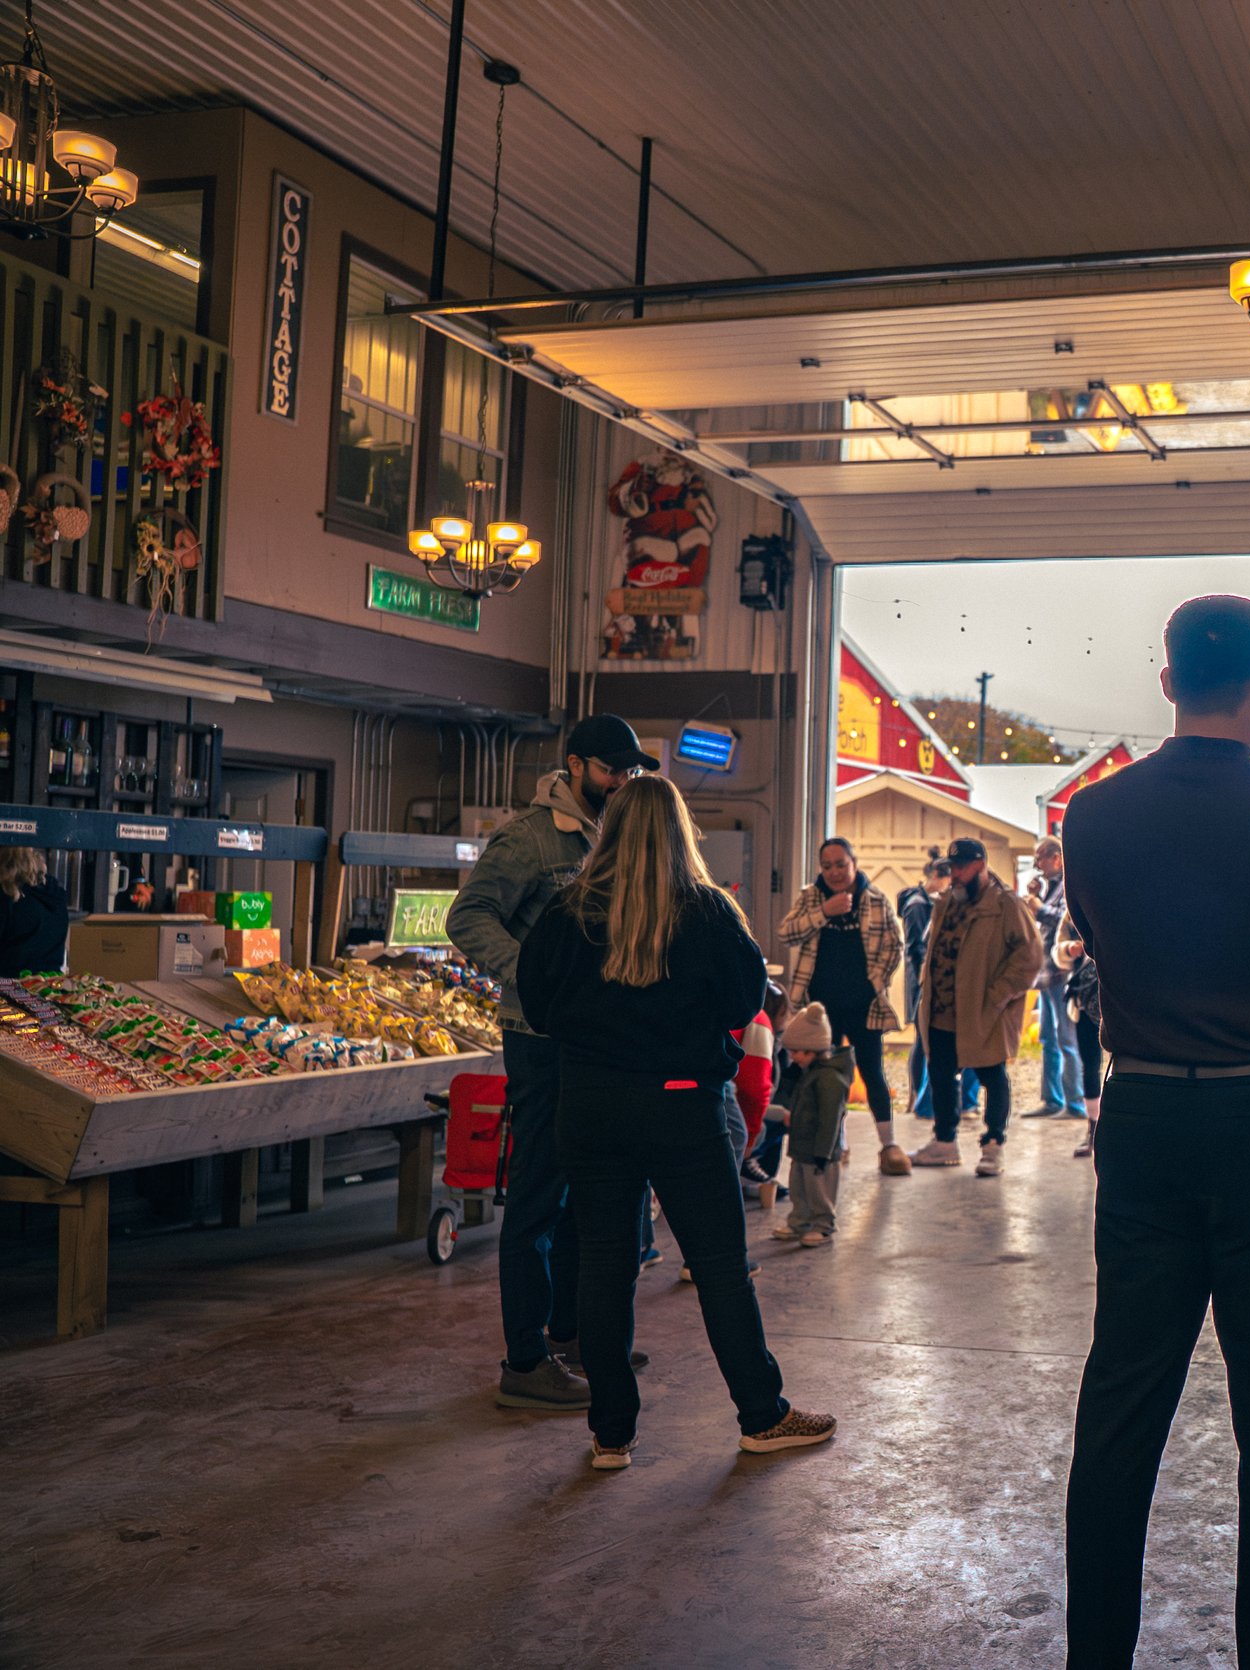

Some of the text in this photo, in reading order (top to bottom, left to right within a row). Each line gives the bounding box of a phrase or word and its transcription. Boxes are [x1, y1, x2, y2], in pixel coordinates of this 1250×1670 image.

[271, 190, 301, 416] COTTAGE
[378, 577, 421, 608] FARM
[241, 900, 265, 911] bubly
